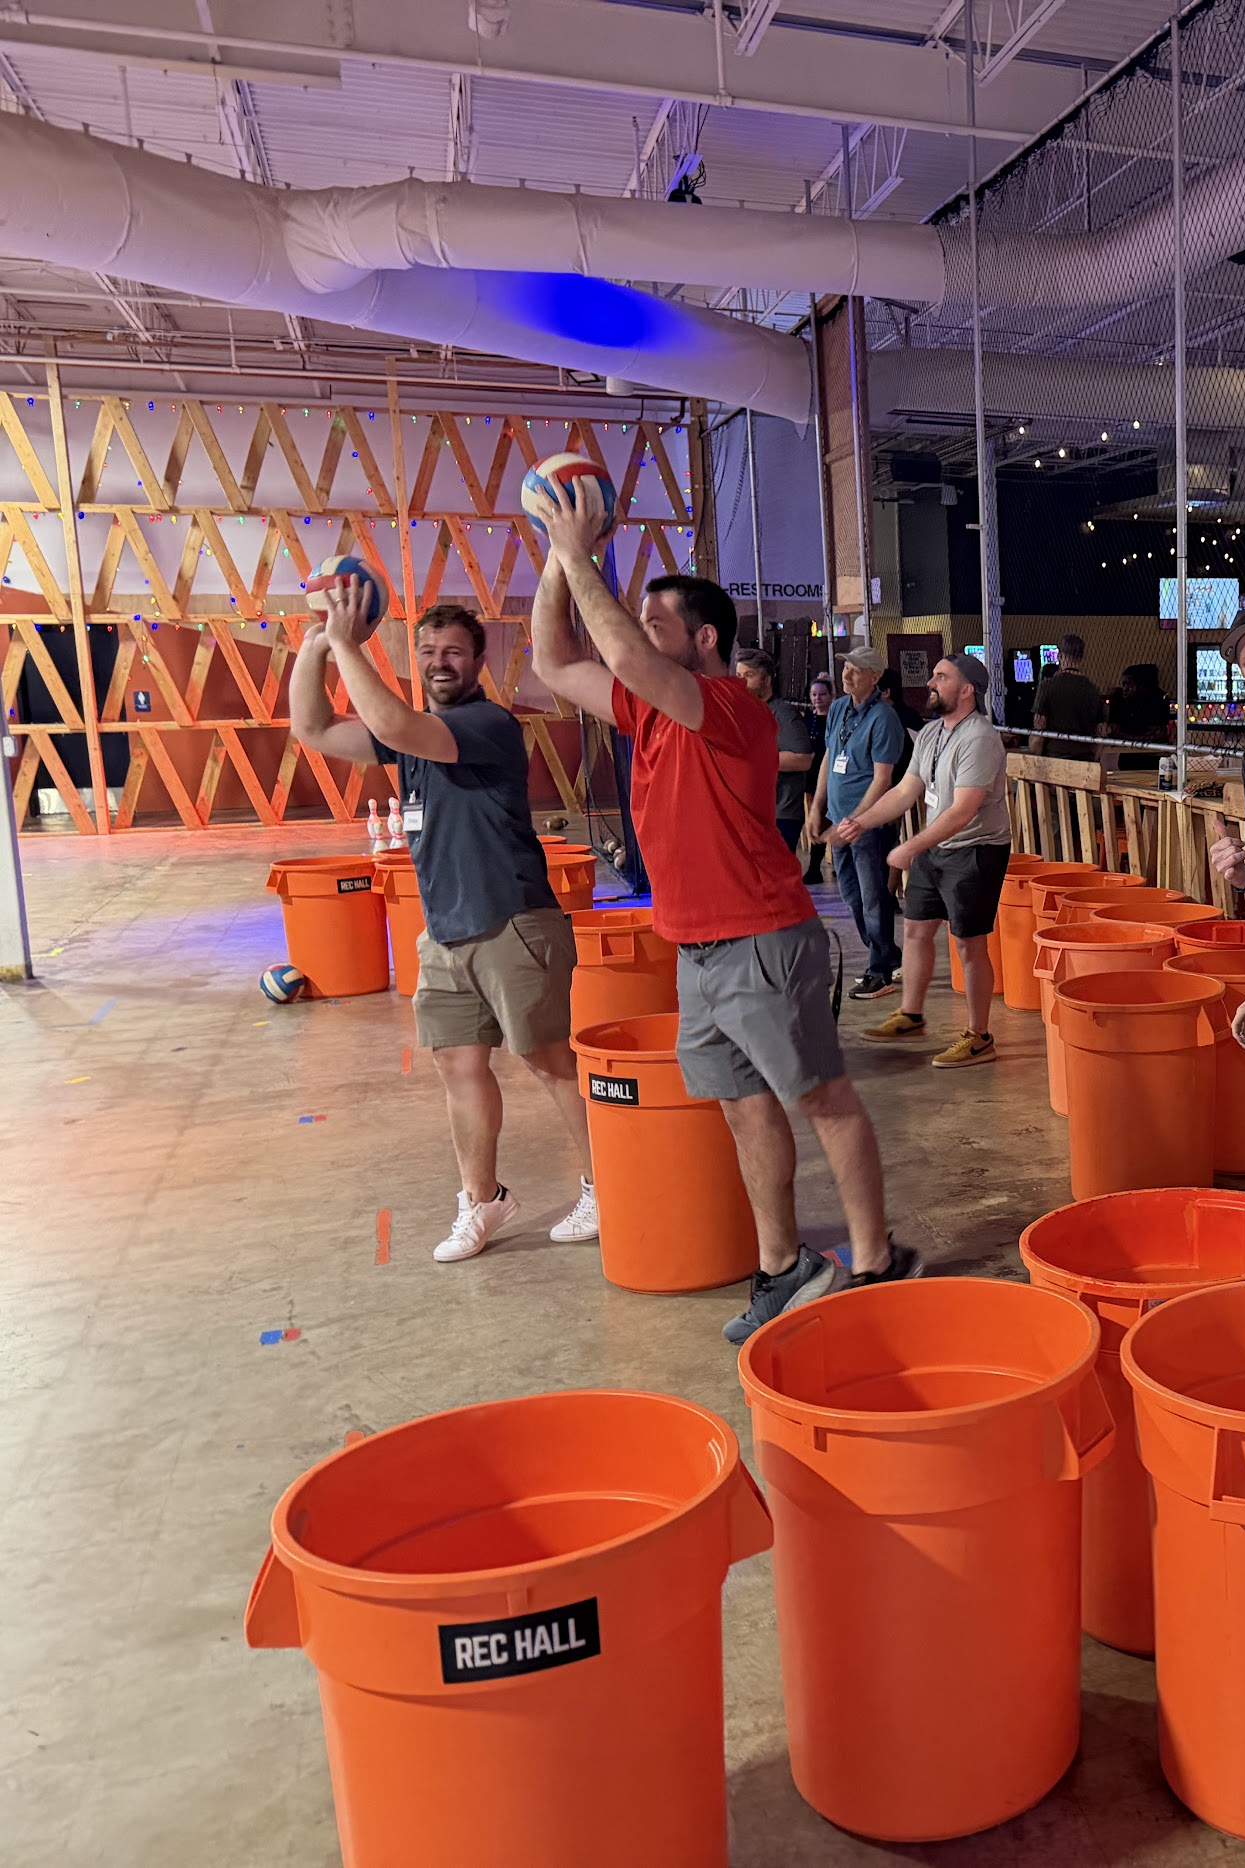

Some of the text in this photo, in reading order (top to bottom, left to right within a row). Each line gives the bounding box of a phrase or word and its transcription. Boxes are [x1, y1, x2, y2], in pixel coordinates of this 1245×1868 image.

[340, 879, 370, 891] REC HALL
[591, 1079, 634, 1100] REC HALL
[454, 1617, 587, 1670] REC HALL
